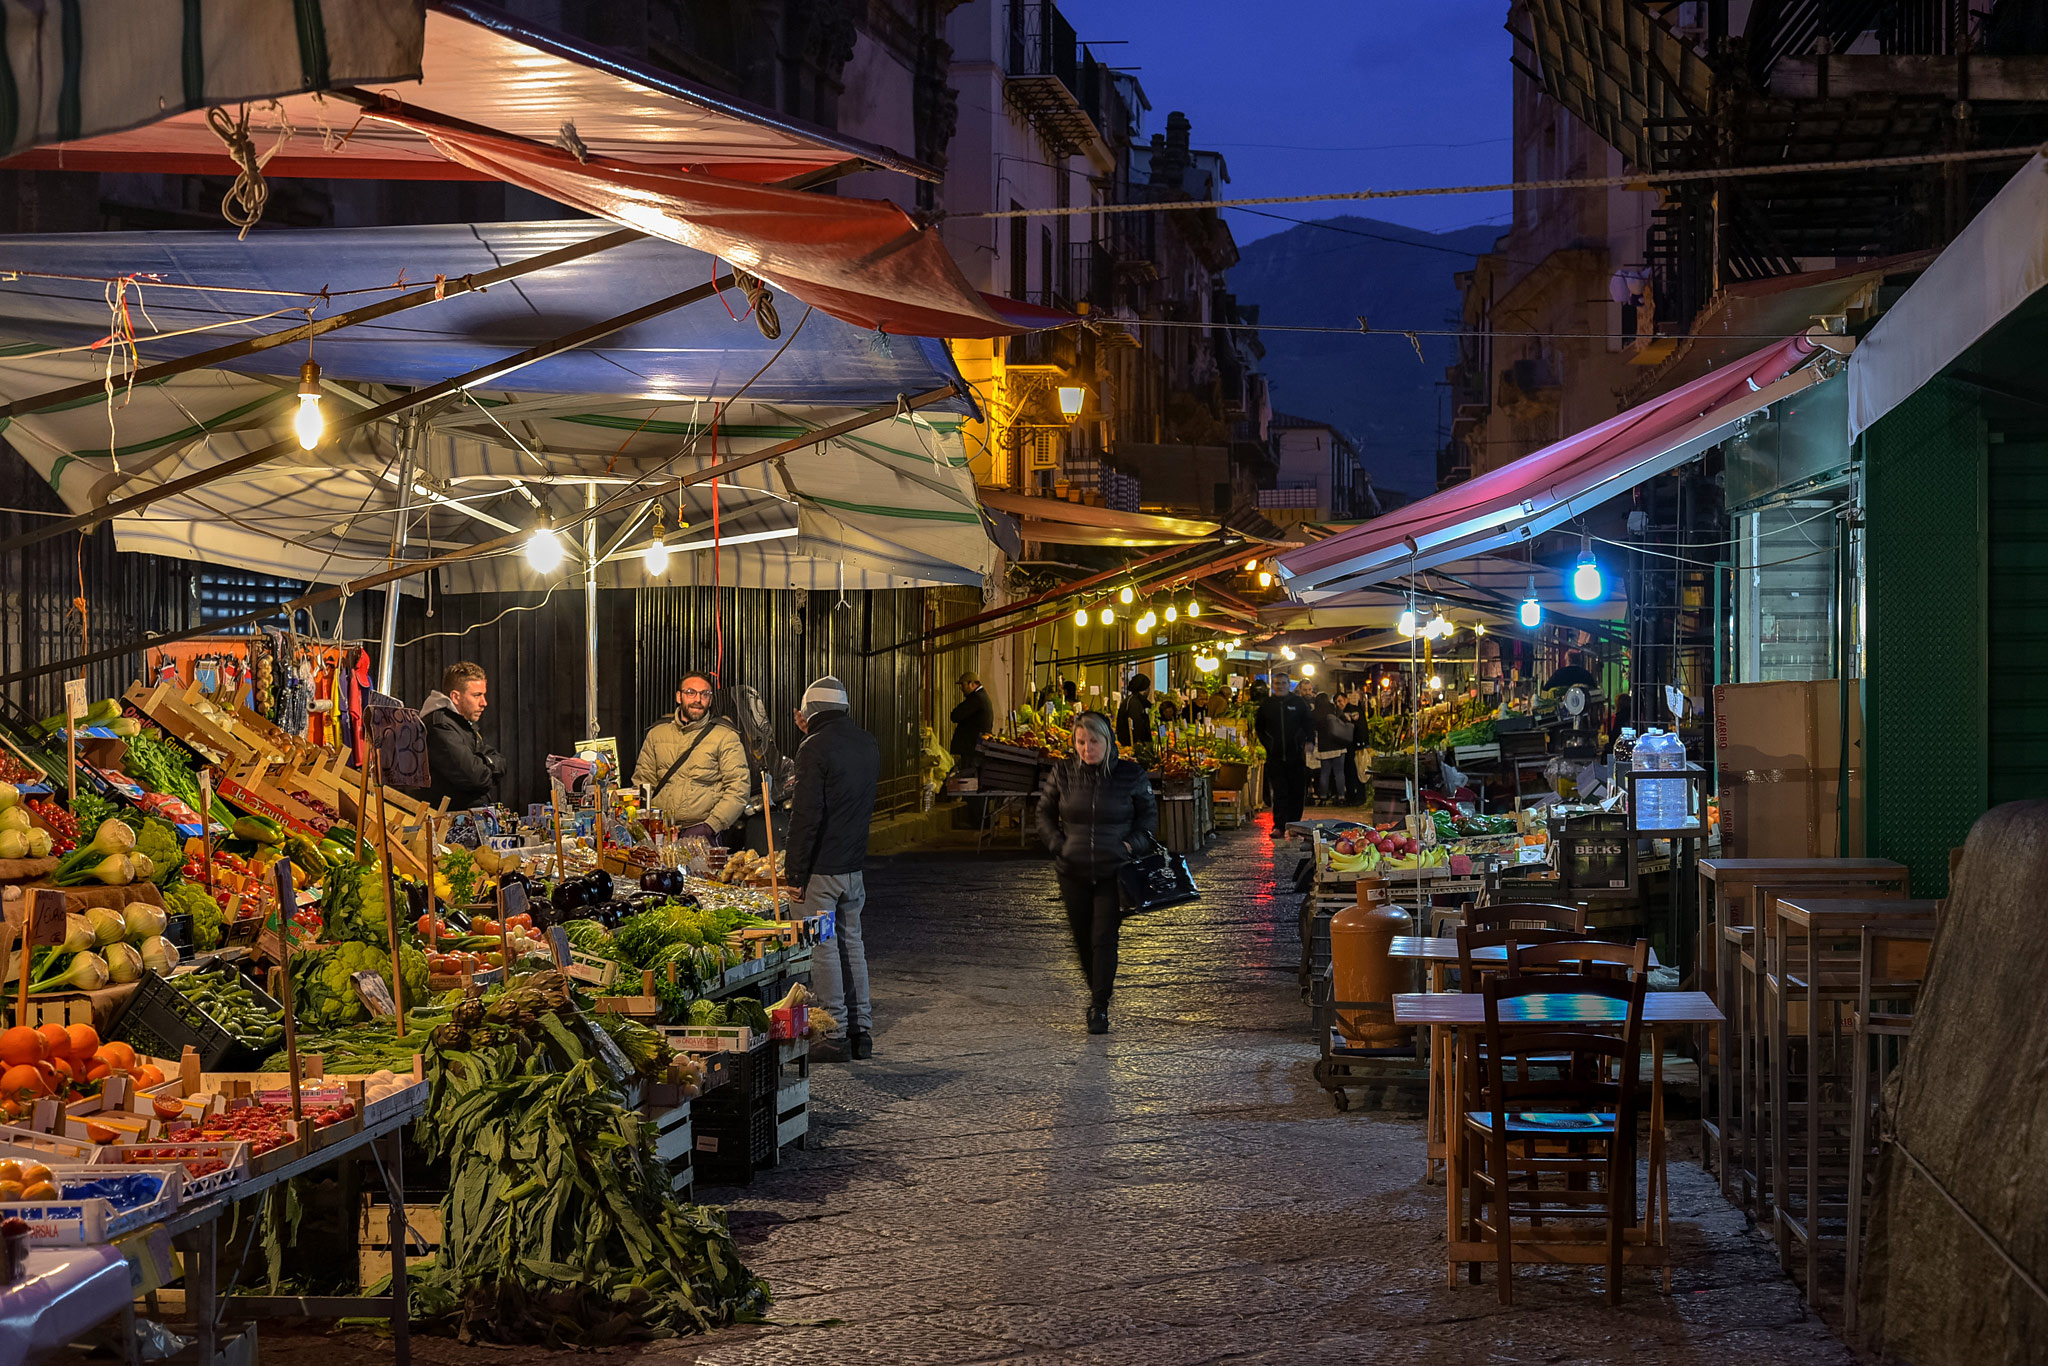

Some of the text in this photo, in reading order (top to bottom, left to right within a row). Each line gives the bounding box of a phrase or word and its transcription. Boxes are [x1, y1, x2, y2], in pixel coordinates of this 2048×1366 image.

[1718, 714, 1728, 749] HARIBO
[231, 785, 247, 801] La
[248, 796, 290, 827] Frutta
[1724, 809, 1734, 845] HARIBO
[1575, 843, 1622, 855] BECK'S
[31, 1225, 59, 1238] ARSALA
